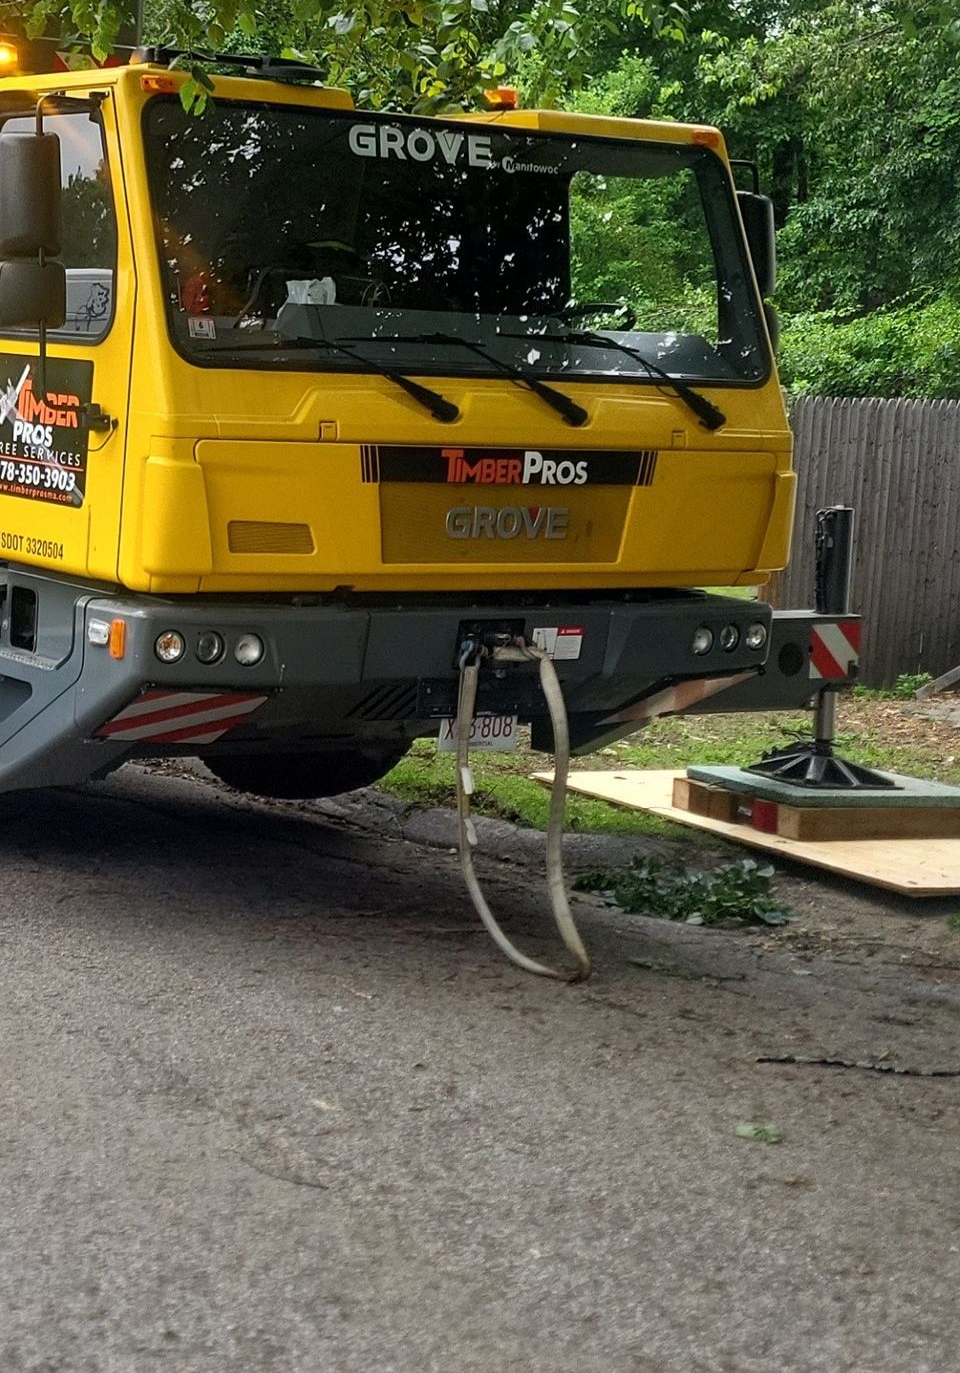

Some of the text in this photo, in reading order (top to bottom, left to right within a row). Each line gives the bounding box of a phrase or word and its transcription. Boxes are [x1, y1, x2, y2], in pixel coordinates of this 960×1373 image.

[348, 124, 559, 175] GROVE Manitowoc
[13, 420, 53, 448] PROS
[24, 445, 81, 467] SERVICES
[445, 506, 568, 540] GROVE
[26, 537, 64, 561] 3320504
